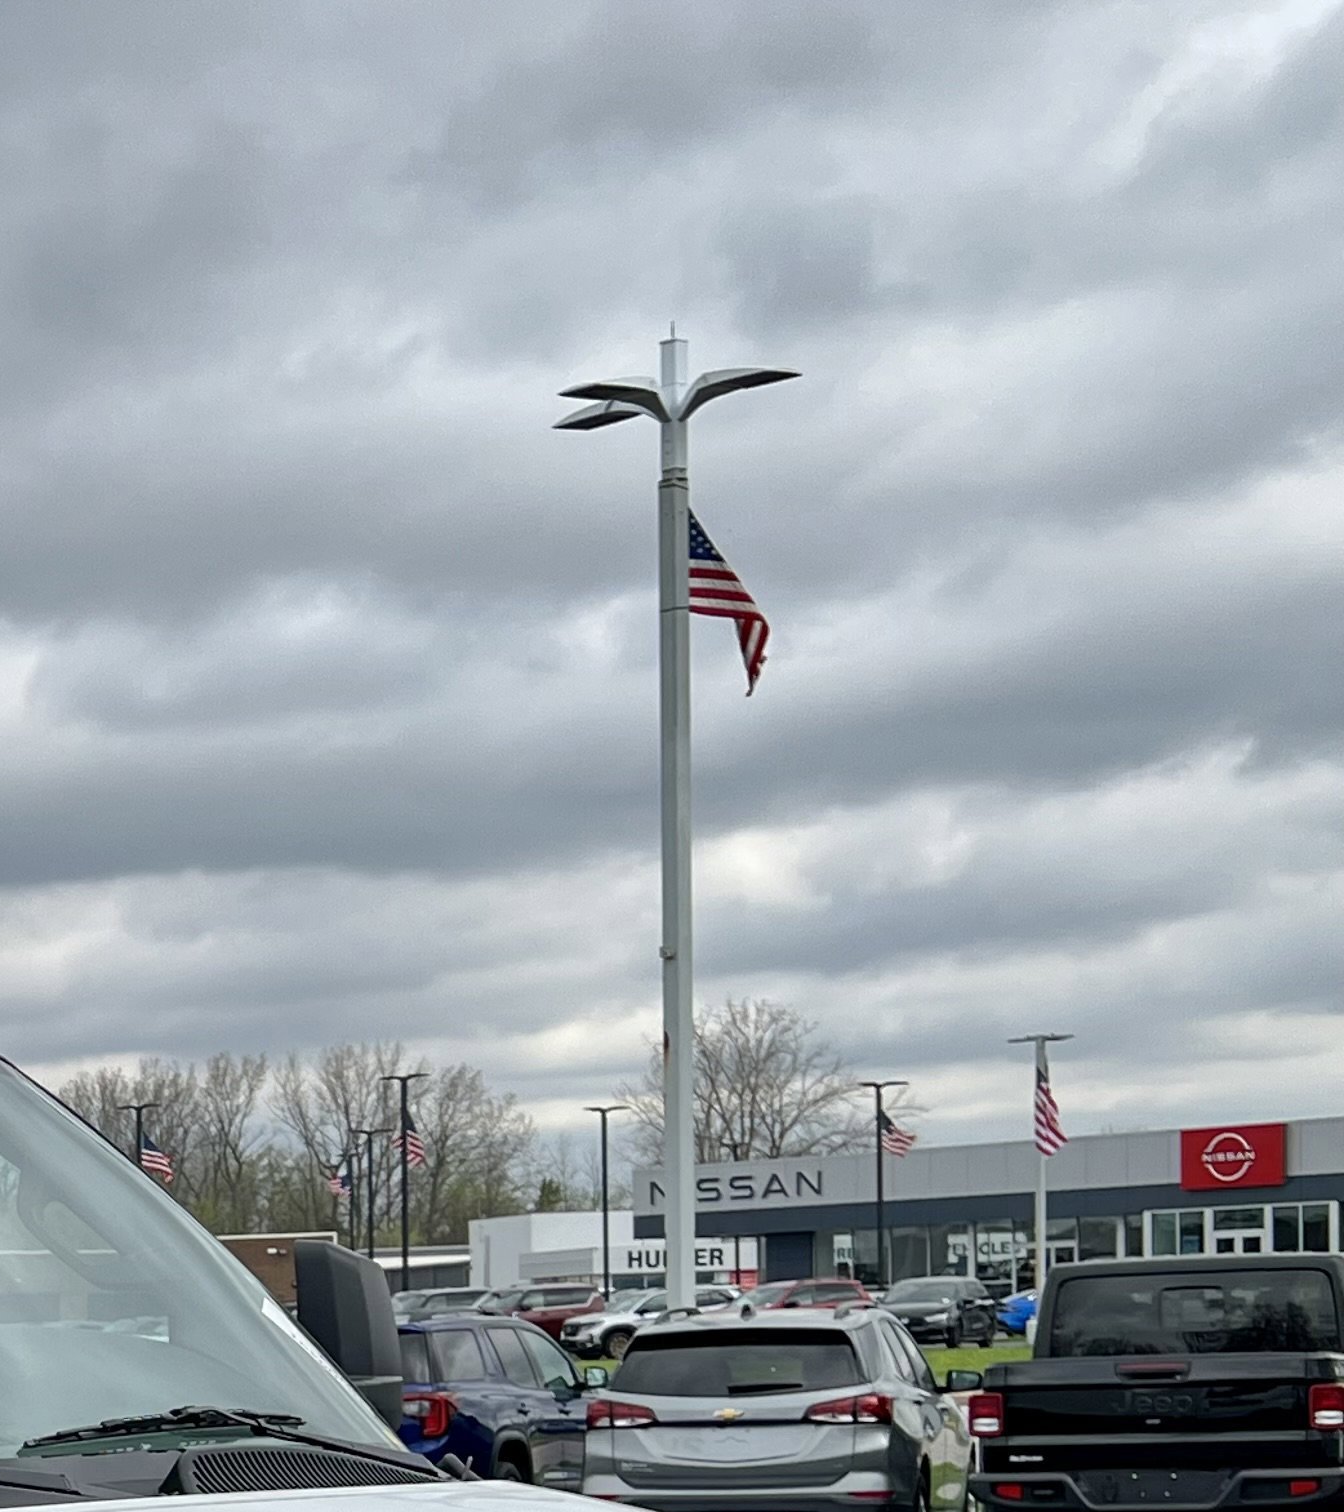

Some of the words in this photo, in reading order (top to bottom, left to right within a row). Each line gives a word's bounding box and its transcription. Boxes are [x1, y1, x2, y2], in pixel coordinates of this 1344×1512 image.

[1201, 1151, 1256, 1162] NISSAN
[649, 1170, 823, 1206] NSSAN
[628, 1249, 724, 1268] HUER
